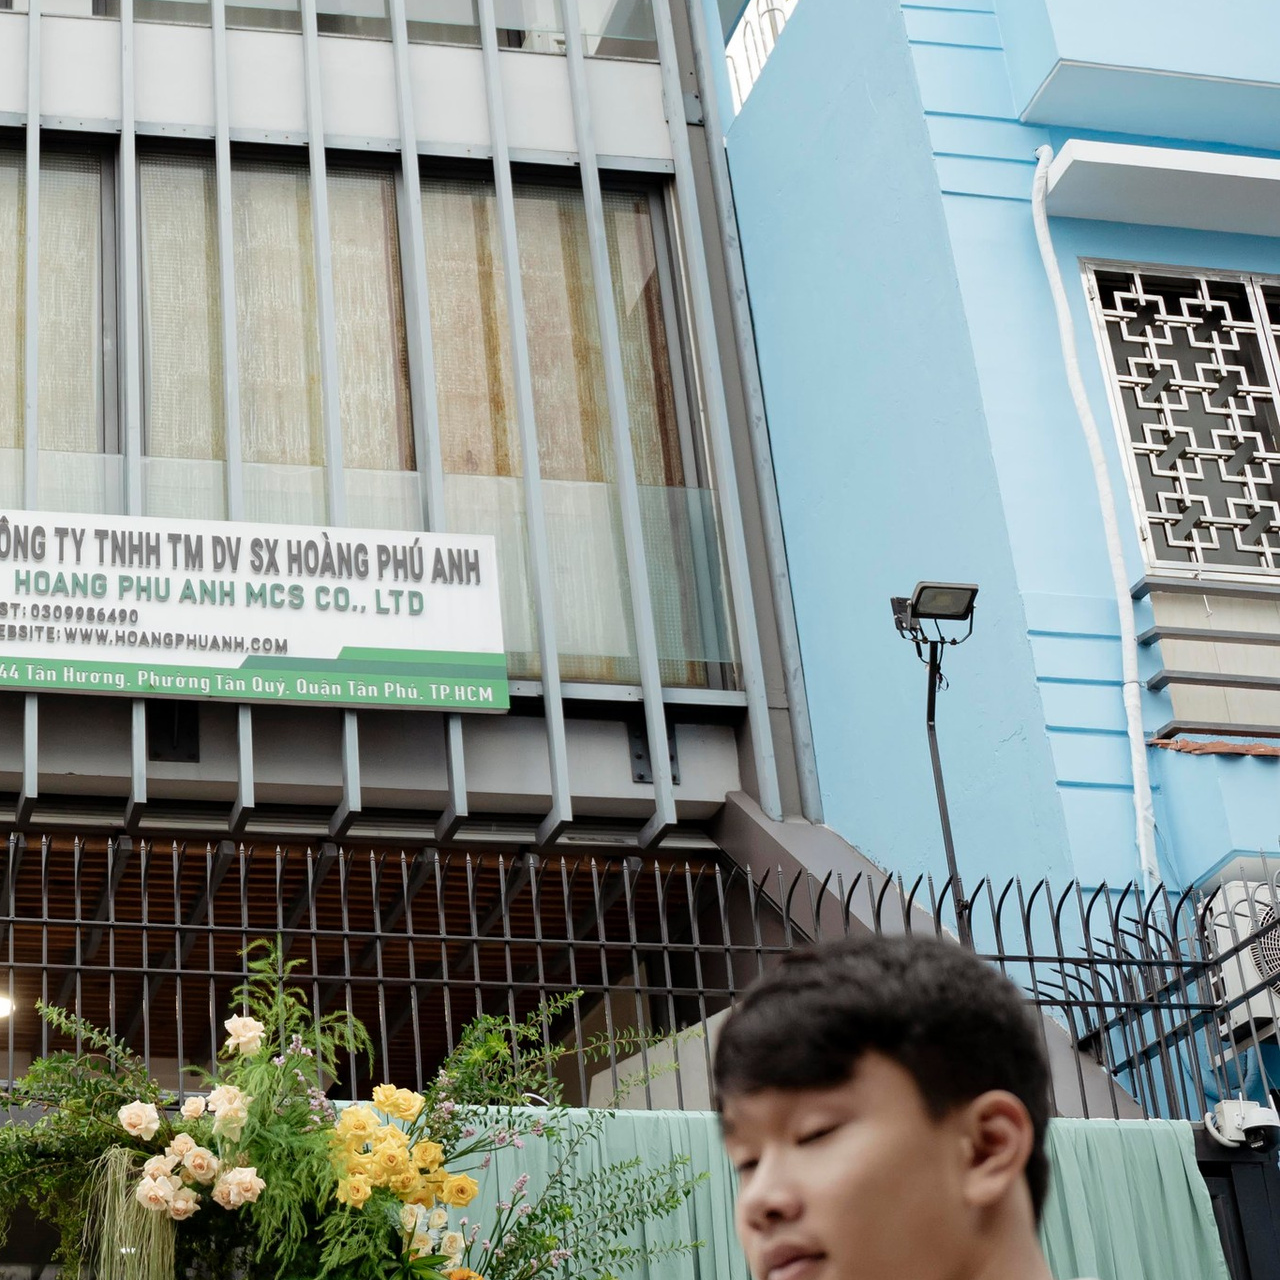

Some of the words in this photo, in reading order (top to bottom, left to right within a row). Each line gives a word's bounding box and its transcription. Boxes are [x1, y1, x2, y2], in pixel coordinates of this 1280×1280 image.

[54, 527, 85, 564] TY
[94, 529, 160, 569] TNHH
[168, 533, 203, 571] TM
[212, 535, 241, 571] DV
[250, 537, 280, 576] SX
[287, 532, 369, 580] HOÀNG
[377, 537, 424, 583] PHÚ
[430, 547, 480, 586] ANH
[15, 569, 107, 598] HOANG
[119, 574, 170, 602] PHU
[179, 578, 235, 606] ANH
[246, 581, 304, 610] MCS
[315, 585, 366, 614] CO.,
[376, 588, 424, 616] LTD
[25, 663, 57, 682] Tân
[138, 669, 210, 693] Phường
[215, 673, 246, 691] Tân
[297, 678, 341, 698] Quận
[347, 680, 378, 697] Tân
[429, 683, 493, 702] TP.HCM
